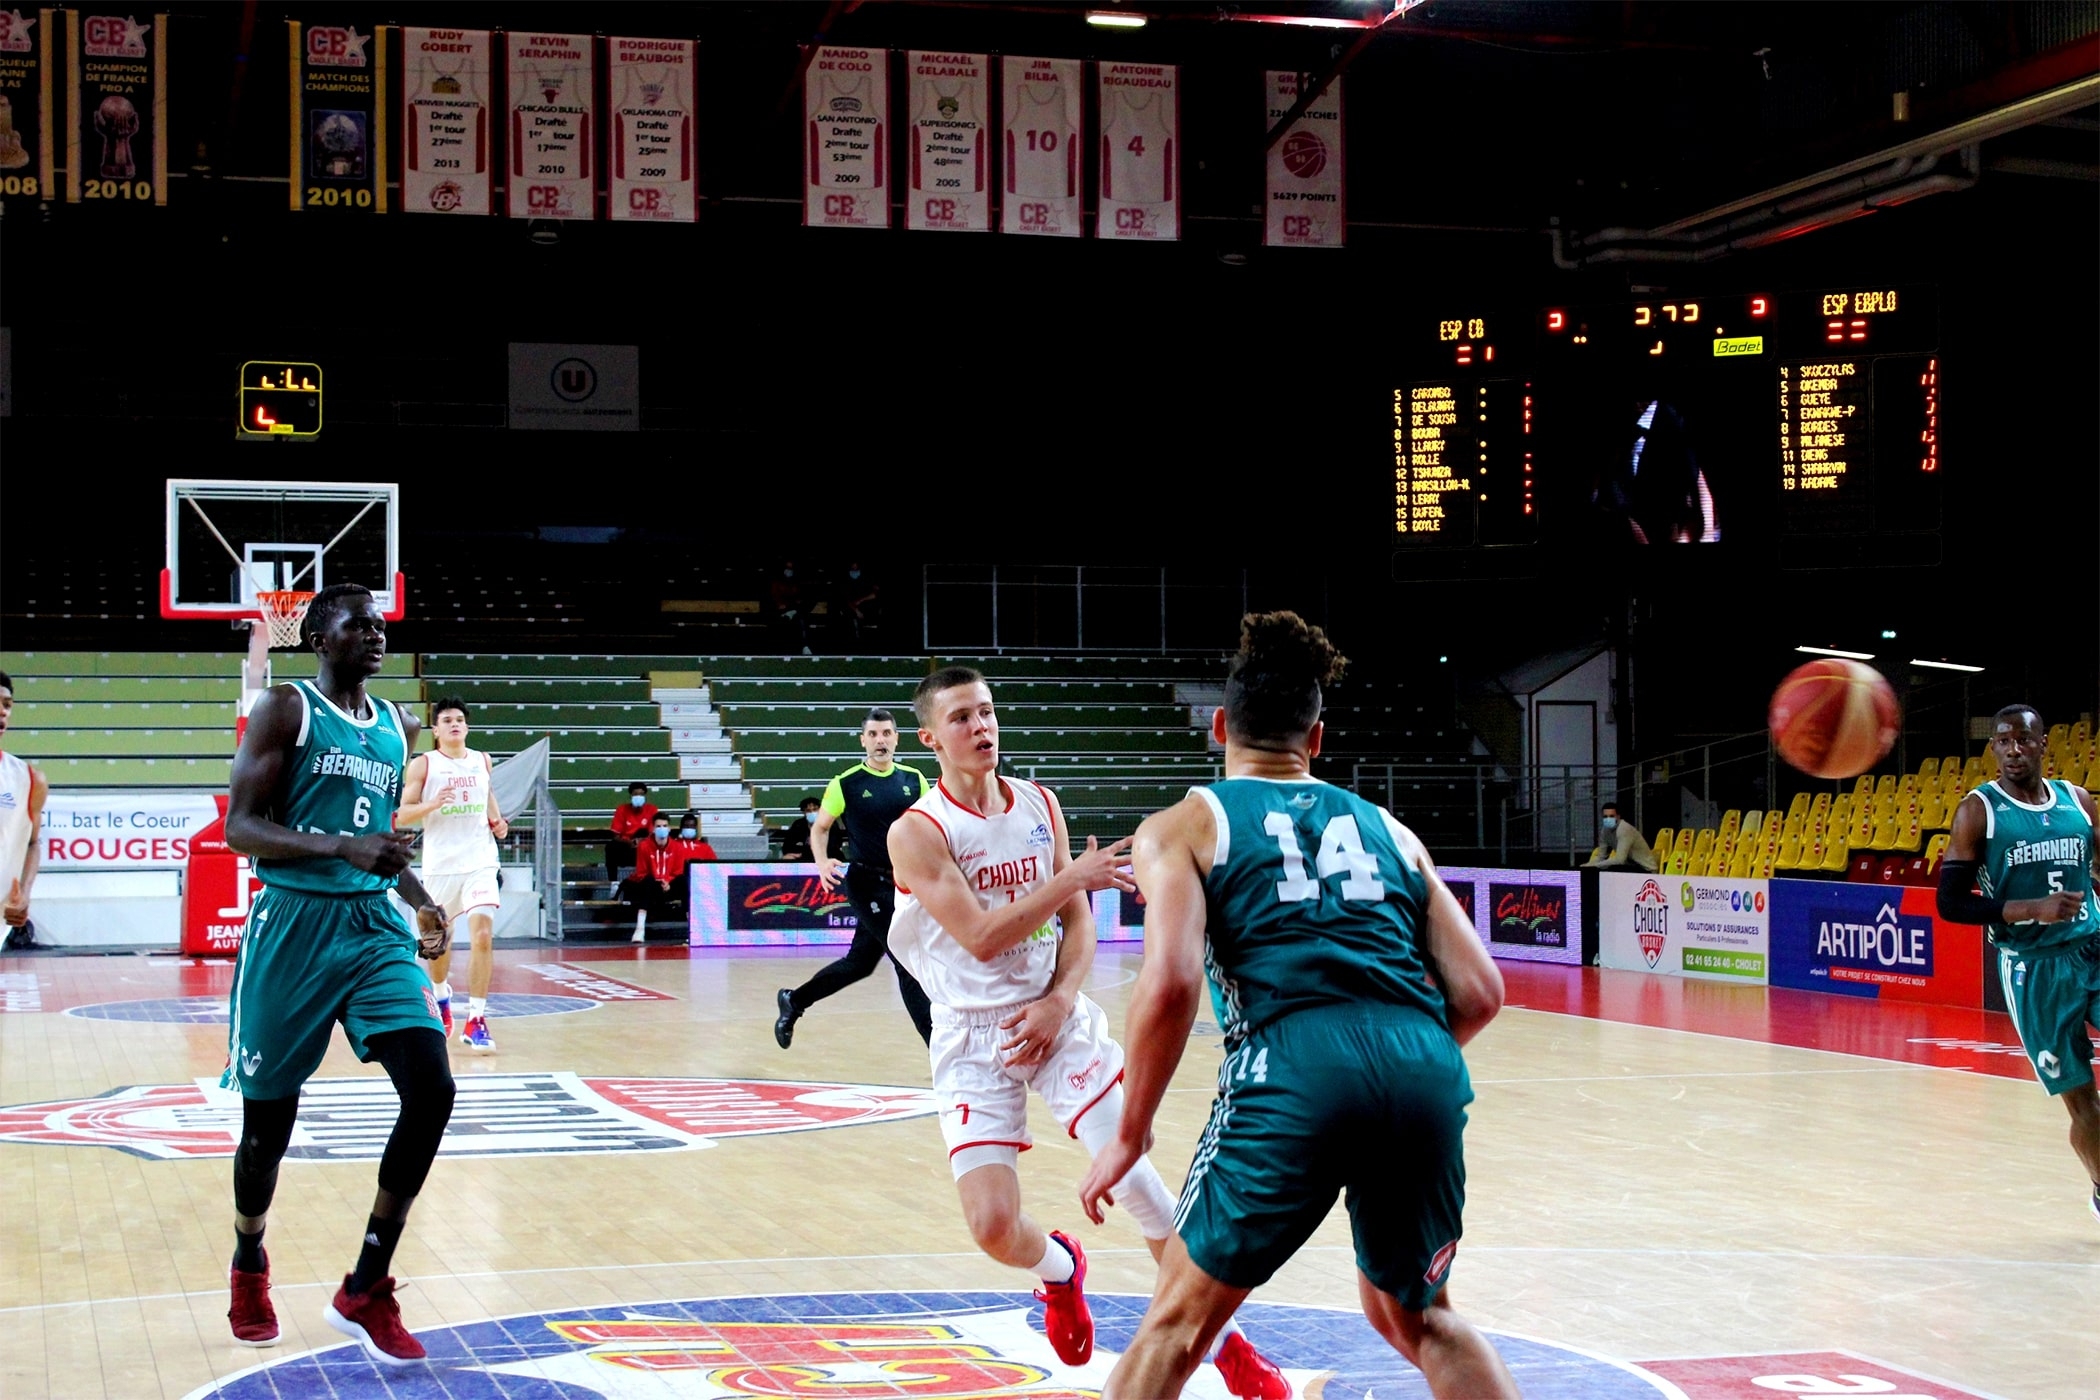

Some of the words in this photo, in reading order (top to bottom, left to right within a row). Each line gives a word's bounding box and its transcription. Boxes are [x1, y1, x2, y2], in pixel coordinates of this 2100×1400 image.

[430, 31, 463, 40] RUDY
[421, 42, 472, 54] GOBERT
[530, 37, 569, 47] KEVIN
[620, 40, 684, 51] RODRIGUE
[518, 49, 581, 60] SERAPHIN
[620, 53, 684, 63] BEAUBOIS
[822, 50, 868, 59] NANDO
[86, 63, 148, 73] CHAMPION
[820, 62, 834, 70] DE
[838, 62, 872, 72] COLO
[917, 66, 978, 77] GELABALE
[1032, 61, 1051, 70] JIM
[1111, 66, 1164, 76] ANTOINE
[86, 73, 100, 82] DE
[103, 74, 148, 84] FRANCE
[308, 72, 348, 82] MATCH
[350, 75, 370, 84] DES
[1025, 72, 1058, 82] BILBA
[1104, 77, 1171, 88] RIGAUDEAU
[100, 84, 122, 92] PRO
[306, 83, 370, 93] CHAMPIONS
[518, 105, 557, 113] CHICAGO
[560, 106, 584, 114] BULLS
[622, 108, 666, 117] OKLAHOMA
[668, 110, 682, 118] CITY
[432, 112, 463, 120] Drafté
[535, 117, 567, 126] Drafté
[818, 114, 834, 122] SAN
[836, 116, 876, 124] ANTONIO
[445, 126, 466, 134] tour
[637, 120, 668, 130] Drafté
[920, 120, 976, 129] SUPERSONICS
[554, 132, 574, 140] tour
[832, 128, 862, 136] Drafté
[934, 132, 964, 141] Drafté
[651, 136, 670, 144] tour
[850, 142, 870, 150] tour
[1026, 130, 1058, 152] 10
[1128, 136, 1145, 156] 4
[950, 146, 970, 154] tour
[434, 158, 460, 168] 2013
[538, 164, 564, 174] 2010
[640, 168, 666, 176] 2009
[834, 174, 860, 182] 2009
[936, 178, 960, 187] 2005
[85, 179, 151, 200] 2010
[307, 187, 371, 208] 2010
[528, 186, 558, 208] CB
[630, 188, 660, 210] CB
[1301, 193, 1336, 202] POINTS
[824, 195, 854, 216] CB
[926, 199, 956, 220] CB
[1020, 203, 1048, 224] CB
[1116, 208, 1144, 230] CB
[1284, 216, 1312, 236] CB
[1823, 294, 1848, 315] ESP
[1855, 291, 1896, 313] EBPLO
[1440, 320, 1462, 340] ESP
[1716, 340, 1762, 354] Bodet
[1781, 367, 1788, 378] 4
[1800, 364, 1855, 378] SKOCZYLAS
[562, 370, 585, 392] U
[1781, 380, 1788, 392] 5
[1394, 389, 1402, 400] 5
[1781, 394, 1788, 406] 6
[1394, 403, 1402, 414] 6
[1412, 400, 1456, 412] DELAUNAY
[1394, 416, 1402, 426] 7
[1412, 414, 1424, 426] DE
[1428, 413, 1456, 425] SOUSA
[1781, 408, 1788, 420] 7
[1781, 422, 1788, 434] 8
[1800, 420, 1838, 434] BORDES
[1394, 428, 1402, 440] 8
[1781, 436, 1789, 448] 9
[1800, 434, 1845, 447] MILANESE
[1394, 442, 1402, 453] 9
[1396, 455, 1406, 466] 11
[1412, 453, 1440, 466] ROLLE
[1783, 450, 1794, 462] 11
[1396, 468, 1407, 480] 12
[1783, 464, 1796, 476] 14
[1396, 481, 1408, 492] 13
[1783, 478, 1796, 490] 19
[1396, 494, 1408, 506] 14
[1412, 493, 1440, 505] LERAY
[1396, 508, 1408, 519] 15
[1396, 520, 1408, 532] 16
[1412, 520, 1440, 532] DOYLE
[321, 754, 392, 791] BEARNAIS
[448, 776, 477, 788] CHOLET
[463, 790, 468, 802] 6
[354, 796, 371, 828] 6
[73, 811, 100, 828] bat
[108, 812, 123, 828] le
[131, 811, 190, 828] Coeur
[48, 838, 188, 860] ROUGES
[2013, 838, 2080, 865] BEARNAIS
[1263, 811, 1385, 902] 14
[977, 856, 1037, 890] CHOLET
[2048, 871, 2063, 895] 5
[1696, 888, 1730, 900] GERMOND
[828, 914, 840, 926] la
[1634, 903, 1669, 935] CHOLET
[1686, 922, 1716, 932] SOLUTIONS
[1723, 924, 1759, 936] ASSURANCES
[1817, 903, 1925, 966] ARTIPÔLE
[1543, 929, 1560, 943] radio
[1686, 954, 1694, 965] 02
[1735, 959, 1762, 970] CHOLET
[1832, 969, 1848, 978] VOTRE
[1848, 971, 1864, 980] PROJET
[1864, 972, 1870, 980] SE
[1871, 974, 1898, 983] CONSTRUIT
[1898, 976, 1911, 985] CHEZ
[1912, 978, 1926, 987] NOUS
[1236, 1046, 1268, 1082] 14
[956, 1103, 970, 1125] 7
